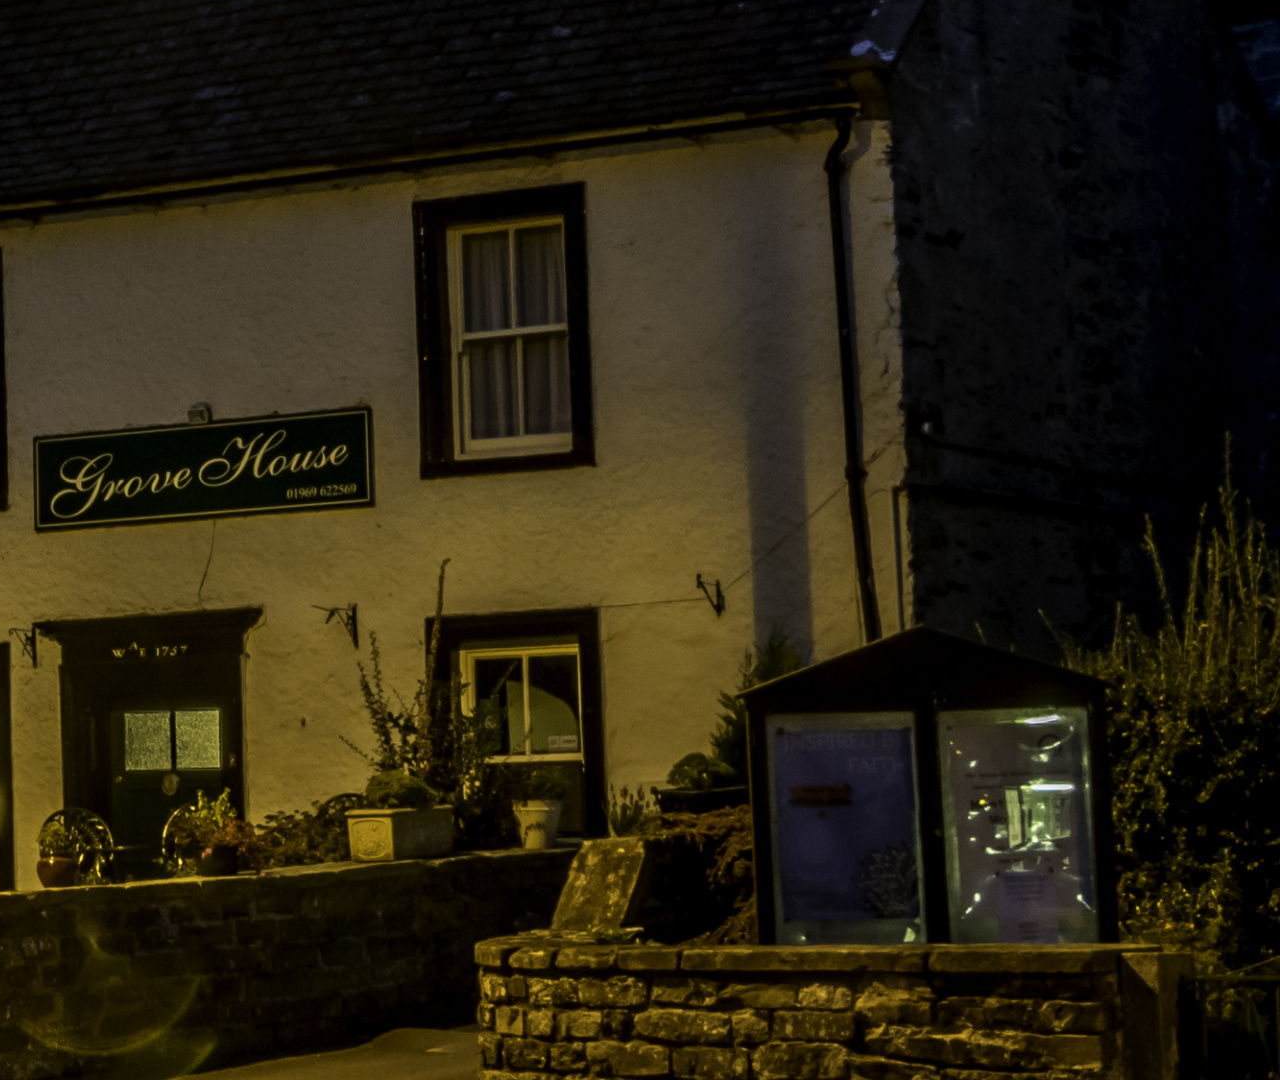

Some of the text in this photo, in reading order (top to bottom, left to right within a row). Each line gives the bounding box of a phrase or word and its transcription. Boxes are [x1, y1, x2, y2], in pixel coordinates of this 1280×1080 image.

[50, 428, 350, 519] Grove House
[286, 483, 357, 500] 01969 622569
[783, 732, 875, 751] INSPIRED
